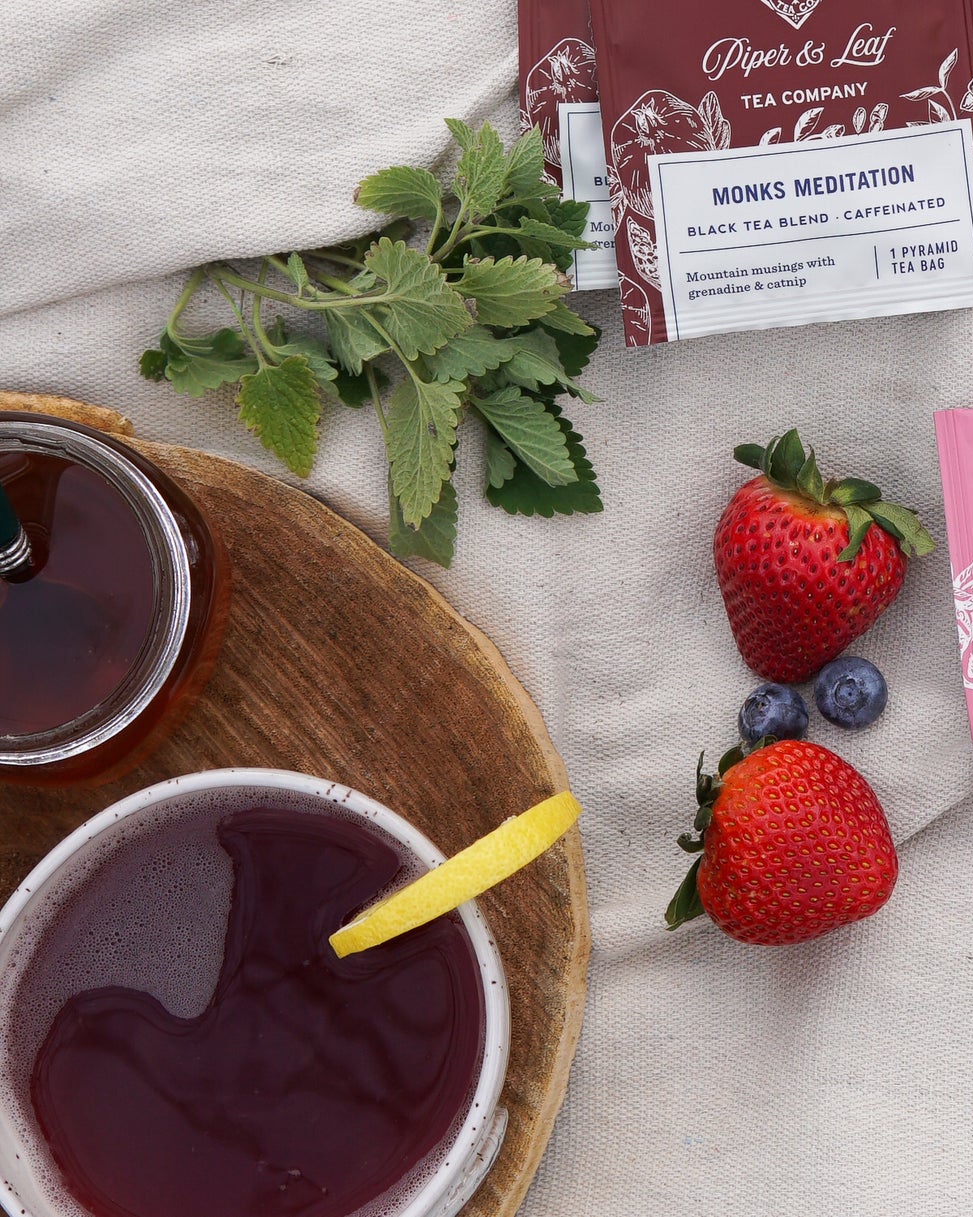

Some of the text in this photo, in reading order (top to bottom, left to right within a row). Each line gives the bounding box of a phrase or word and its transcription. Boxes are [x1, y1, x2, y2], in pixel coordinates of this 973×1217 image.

[776, 0, 795, 14] TEA
[702, 23, 896, 81] Piper & Leaf
[741, 82, 867, 109] TEA COMPANY
[712, 164, 914, 206] MONKS MEDITATION
[688, 197, 945, 237] BLACK TEA BLEND CAFFEINATED
[890, 240, 958, 259] 1 PYRAMID
[686, 256, 835, 282] Mountain musings with
[891, 258, 944, 274] TEA BAG
[689, 276, 806, 300] grenadine & catnip
